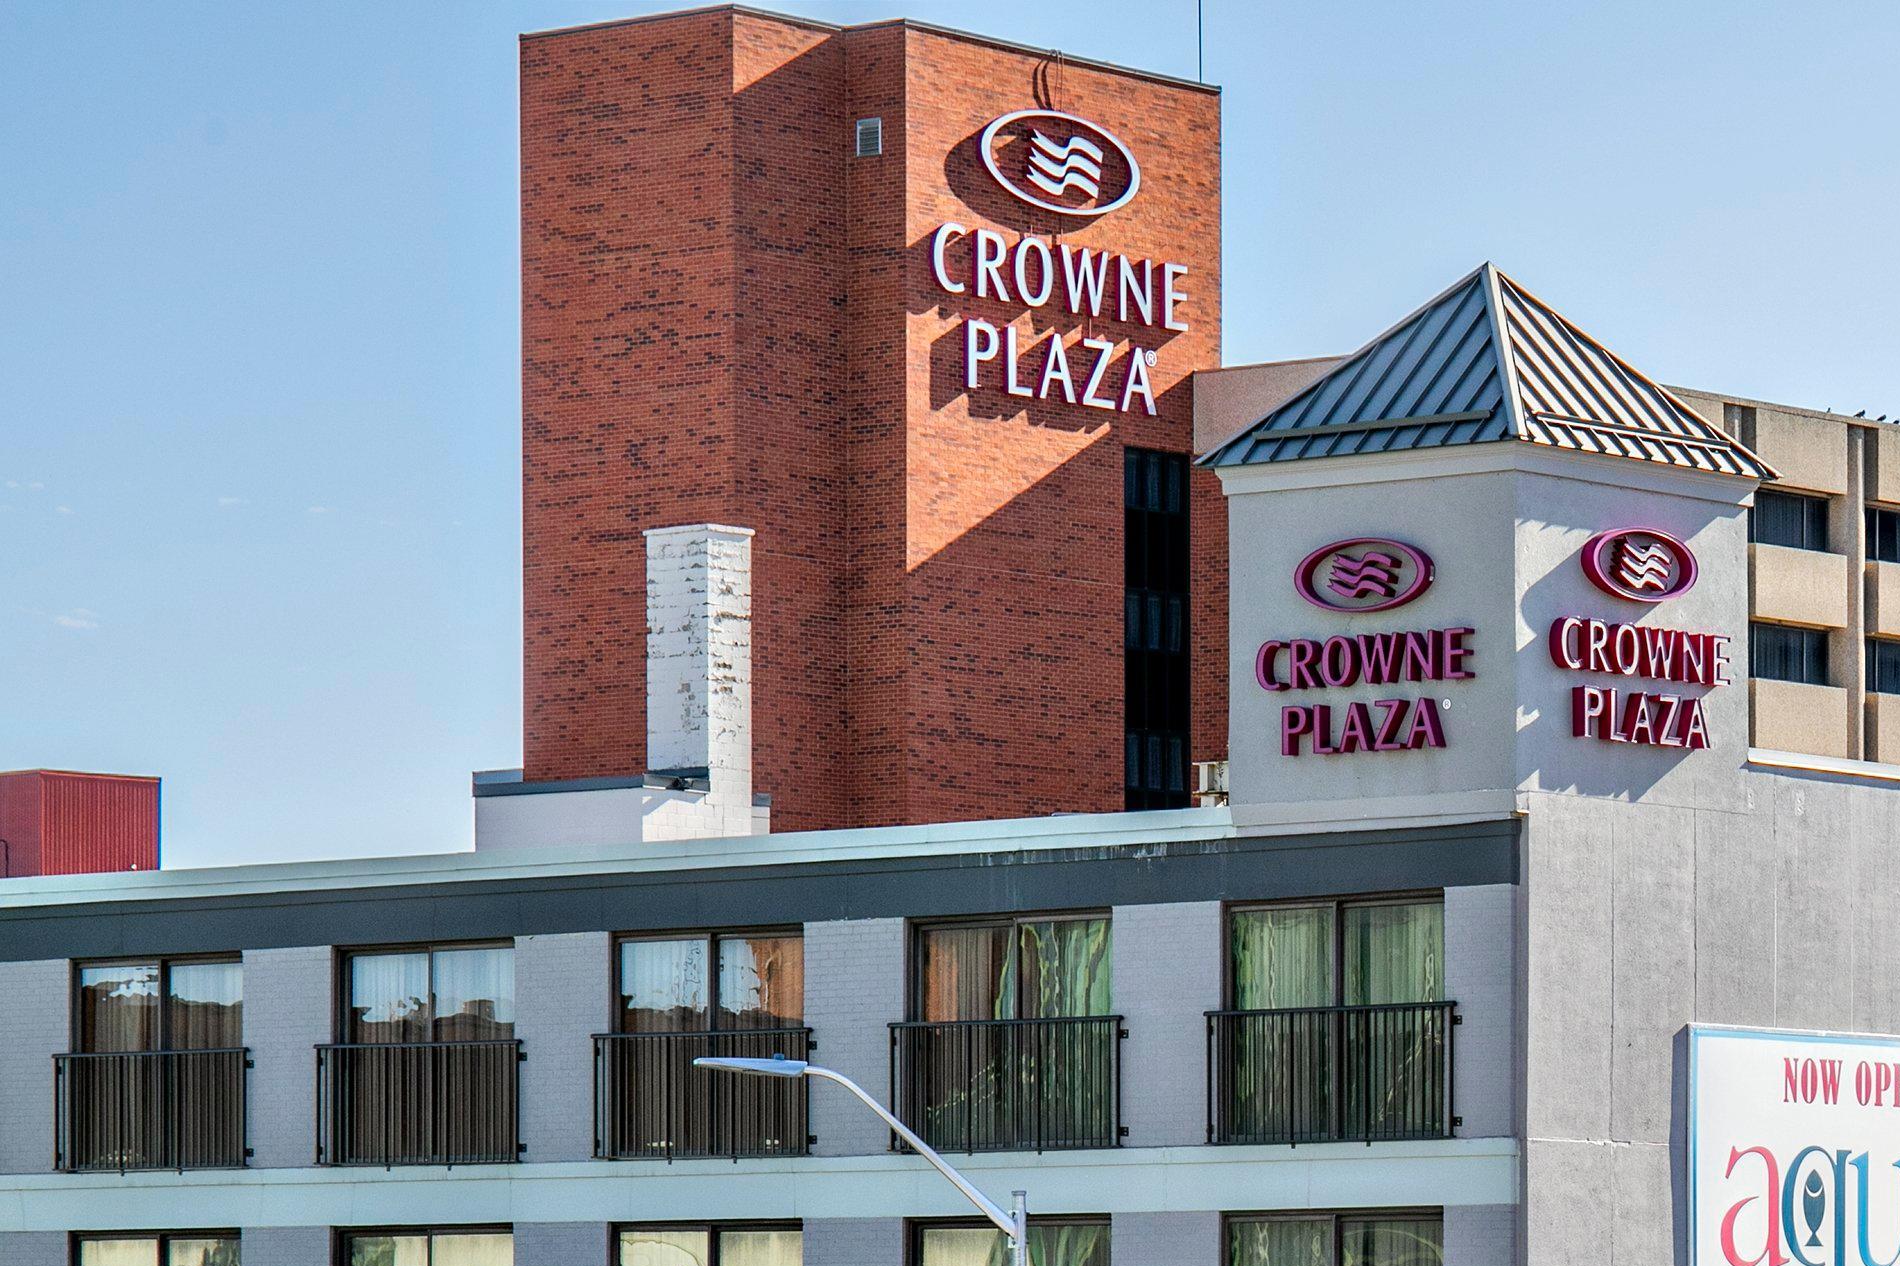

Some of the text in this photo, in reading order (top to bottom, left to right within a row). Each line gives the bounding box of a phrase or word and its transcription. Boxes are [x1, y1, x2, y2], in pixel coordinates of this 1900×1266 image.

[930, 222, 1188, 331] CROWNE
[1256, 628, 1475, 692] CROWNE
[1551, 616, 1731, 686] CROWNE
[1573, 685, 1710, 749] PLAZA
[1783, 1058, 1842, 1105] NOW
